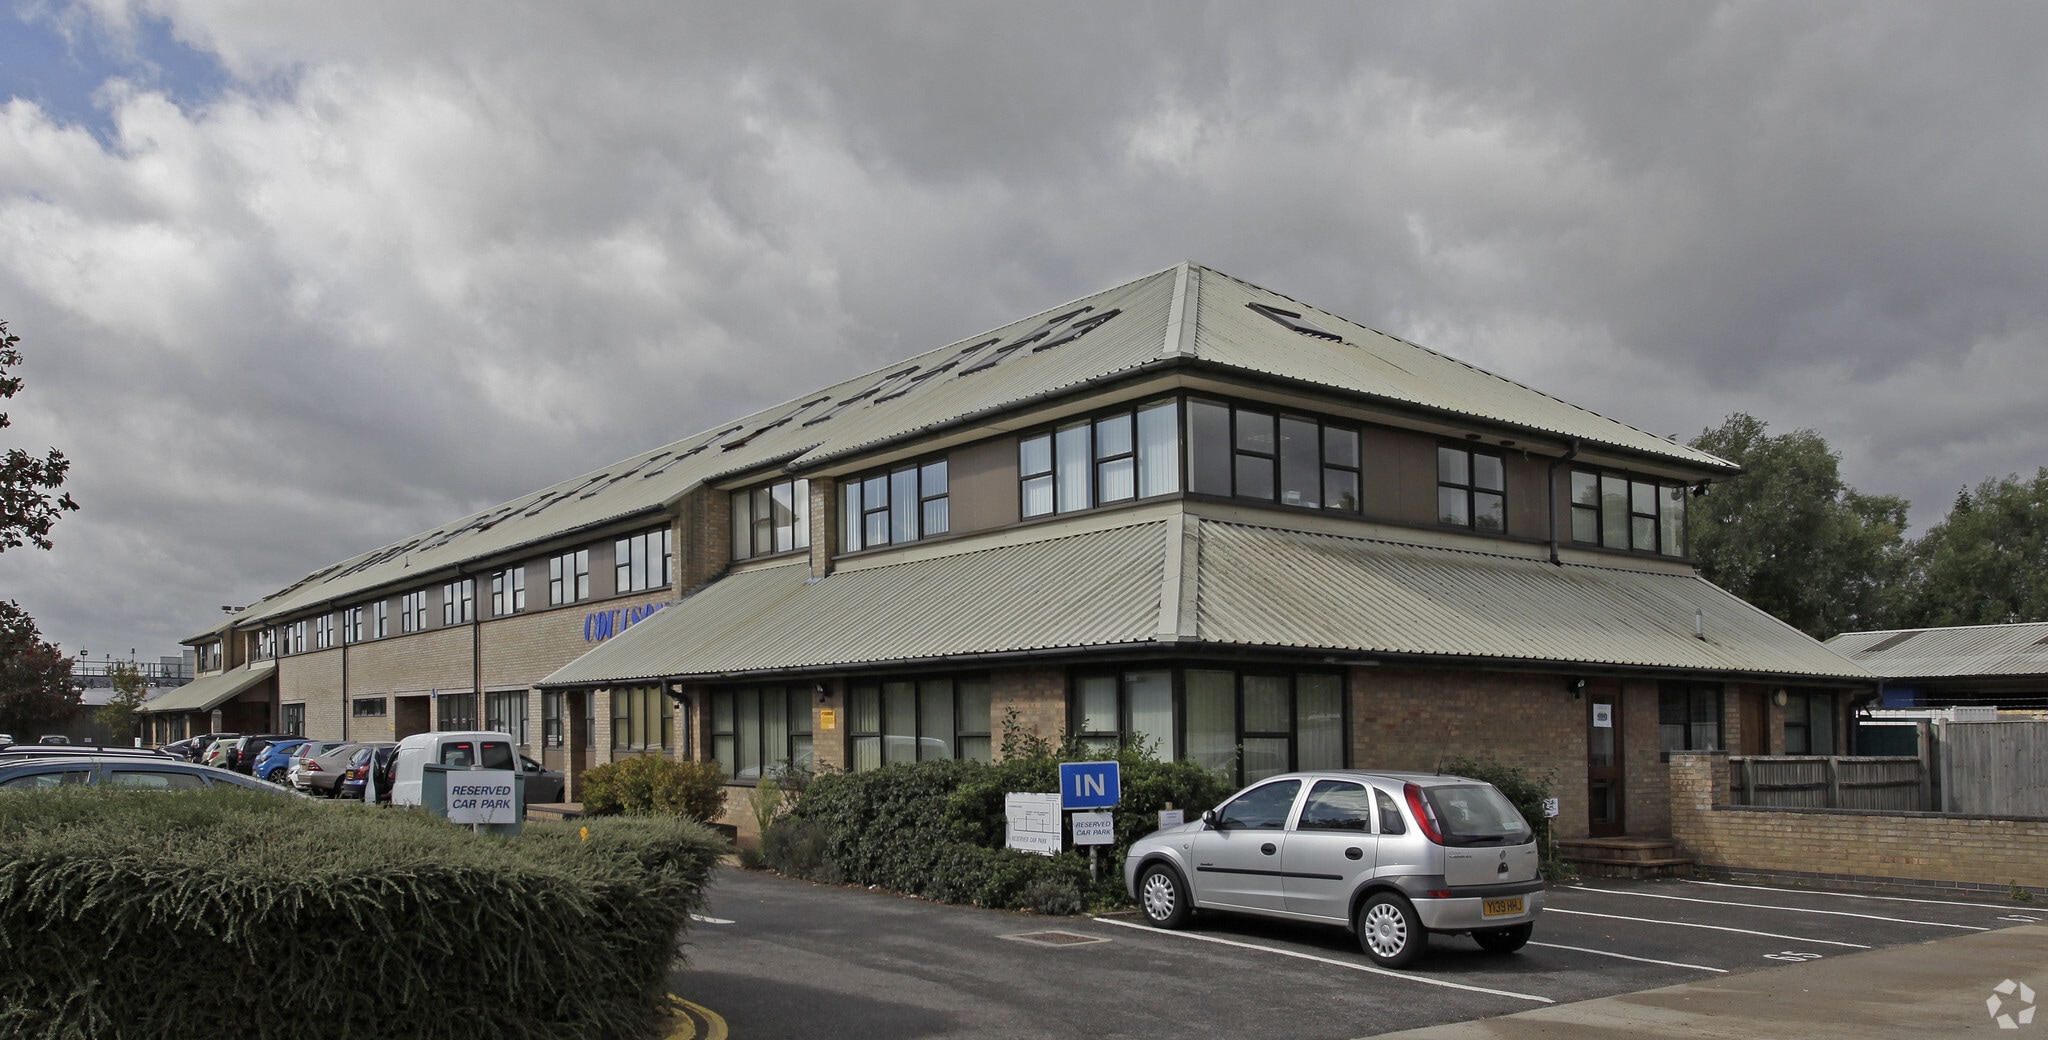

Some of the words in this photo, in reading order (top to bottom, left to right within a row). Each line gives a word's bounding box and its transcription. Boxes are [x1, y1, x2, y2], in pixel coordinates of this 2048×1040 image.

[452, 786, 511, 795] RESERVED
[1075, 774, 1105, 797] IN
[452, 799, 477, 808] CAR
[480, 799, 511, 808] PARK
[1487, 899, 1506, 913] Y139
[1507, 899, 1522, 911] HHJ
